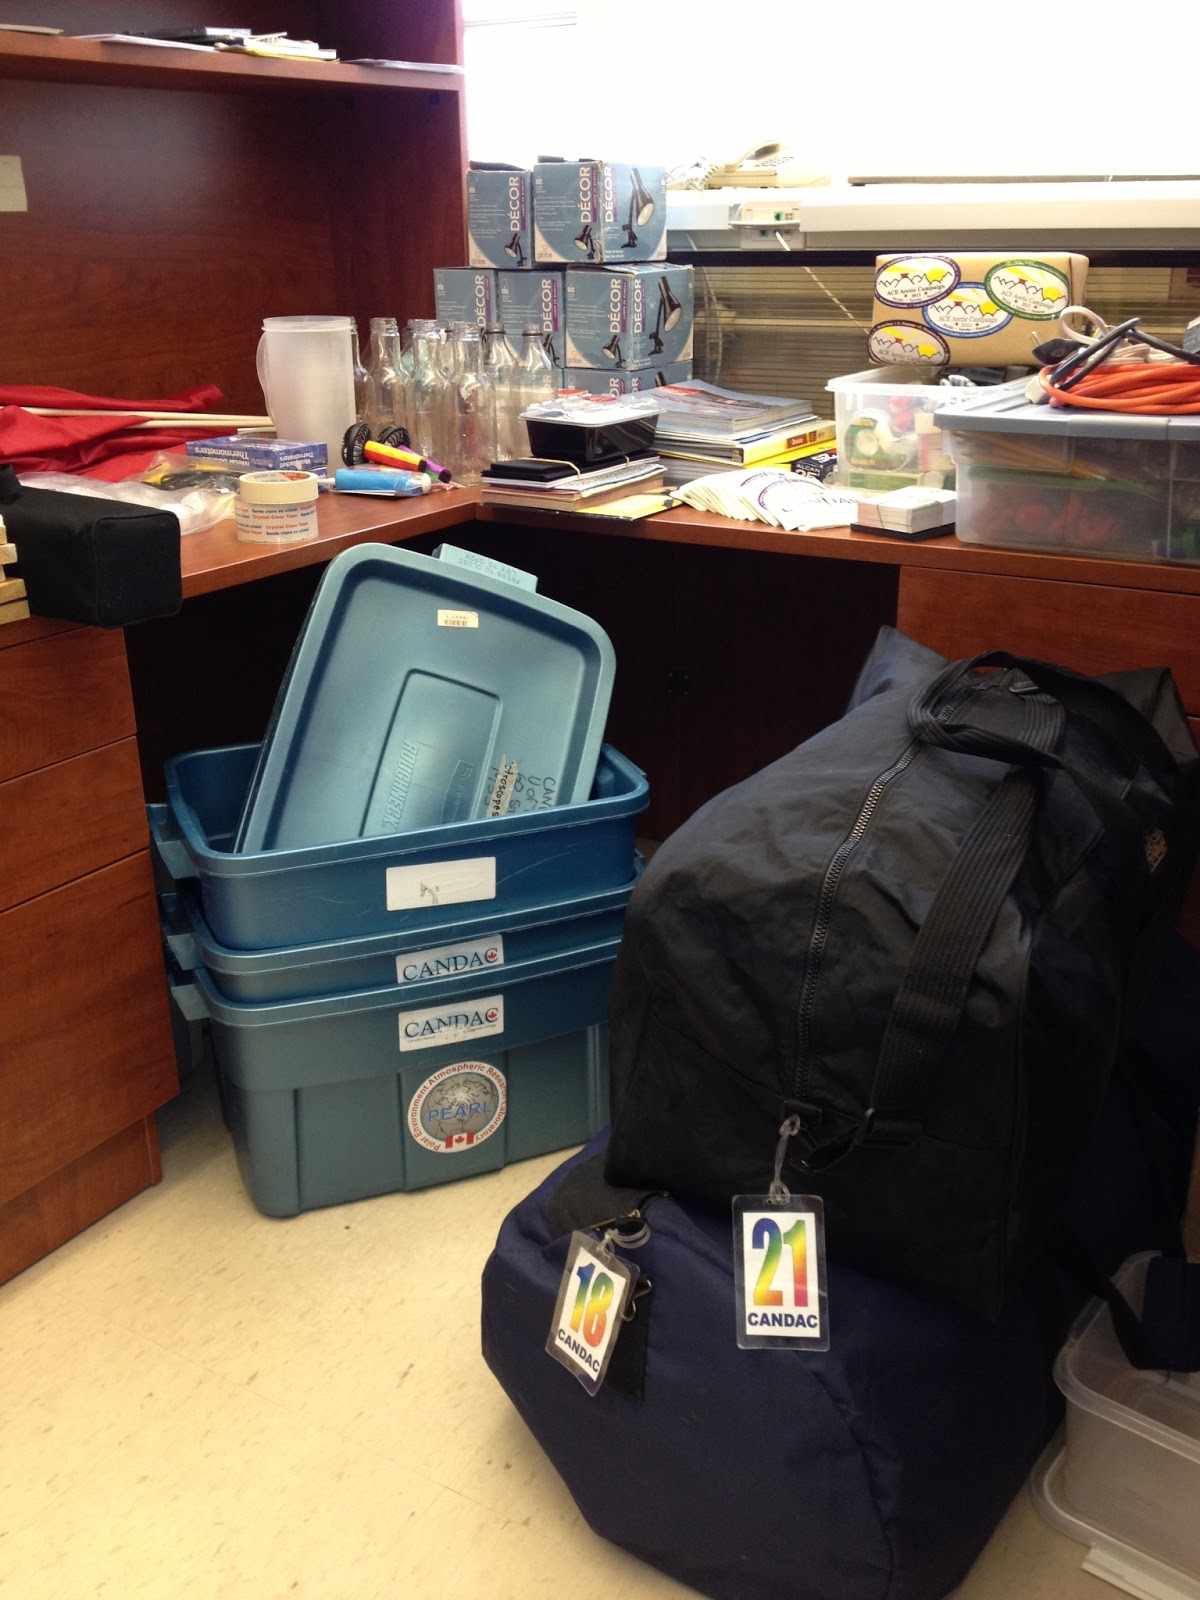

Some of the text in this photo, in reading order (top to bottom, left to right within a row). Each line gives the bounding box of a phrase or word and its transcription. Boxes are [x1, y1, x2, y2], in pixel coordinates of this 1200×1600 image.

[507, 176, 520, 231] DÉCOR
[577, 166, 591, 223] DÉCOR
[603, 166, 613, 223] DÉCOR
[474, 275, 486, 327] DÉCOR
[540, 279, 553, 332] DÉCOR
[607, 278, 621, 333] DÉCOR
[194, 447, 250, 460] Thermometers
[796, 464, 820, 473] ALCAN
[381, 741, 420, 831] ROUGHNECK
[491, 760, 516, 817] ctroscopes
[540, 776, 557, 810] CAN
[402, 947, 499, 981] CANDAC
[404, 1007, 499, 1038] CANDAC
[428, 1063, 486, 1086] Atmospheric
[411, 1085, 430, 1138] Environment
[428, 1100, 492, 1122] PEARL
[420, 1137, 442, 1151] Polar
[752, 1217, 809, 1308] 21
[569, 1262, 615, 1348] 18
[747, 1312, 819, 1328] CANDAC
[557, 1328, 601, 1373] CANDAC
